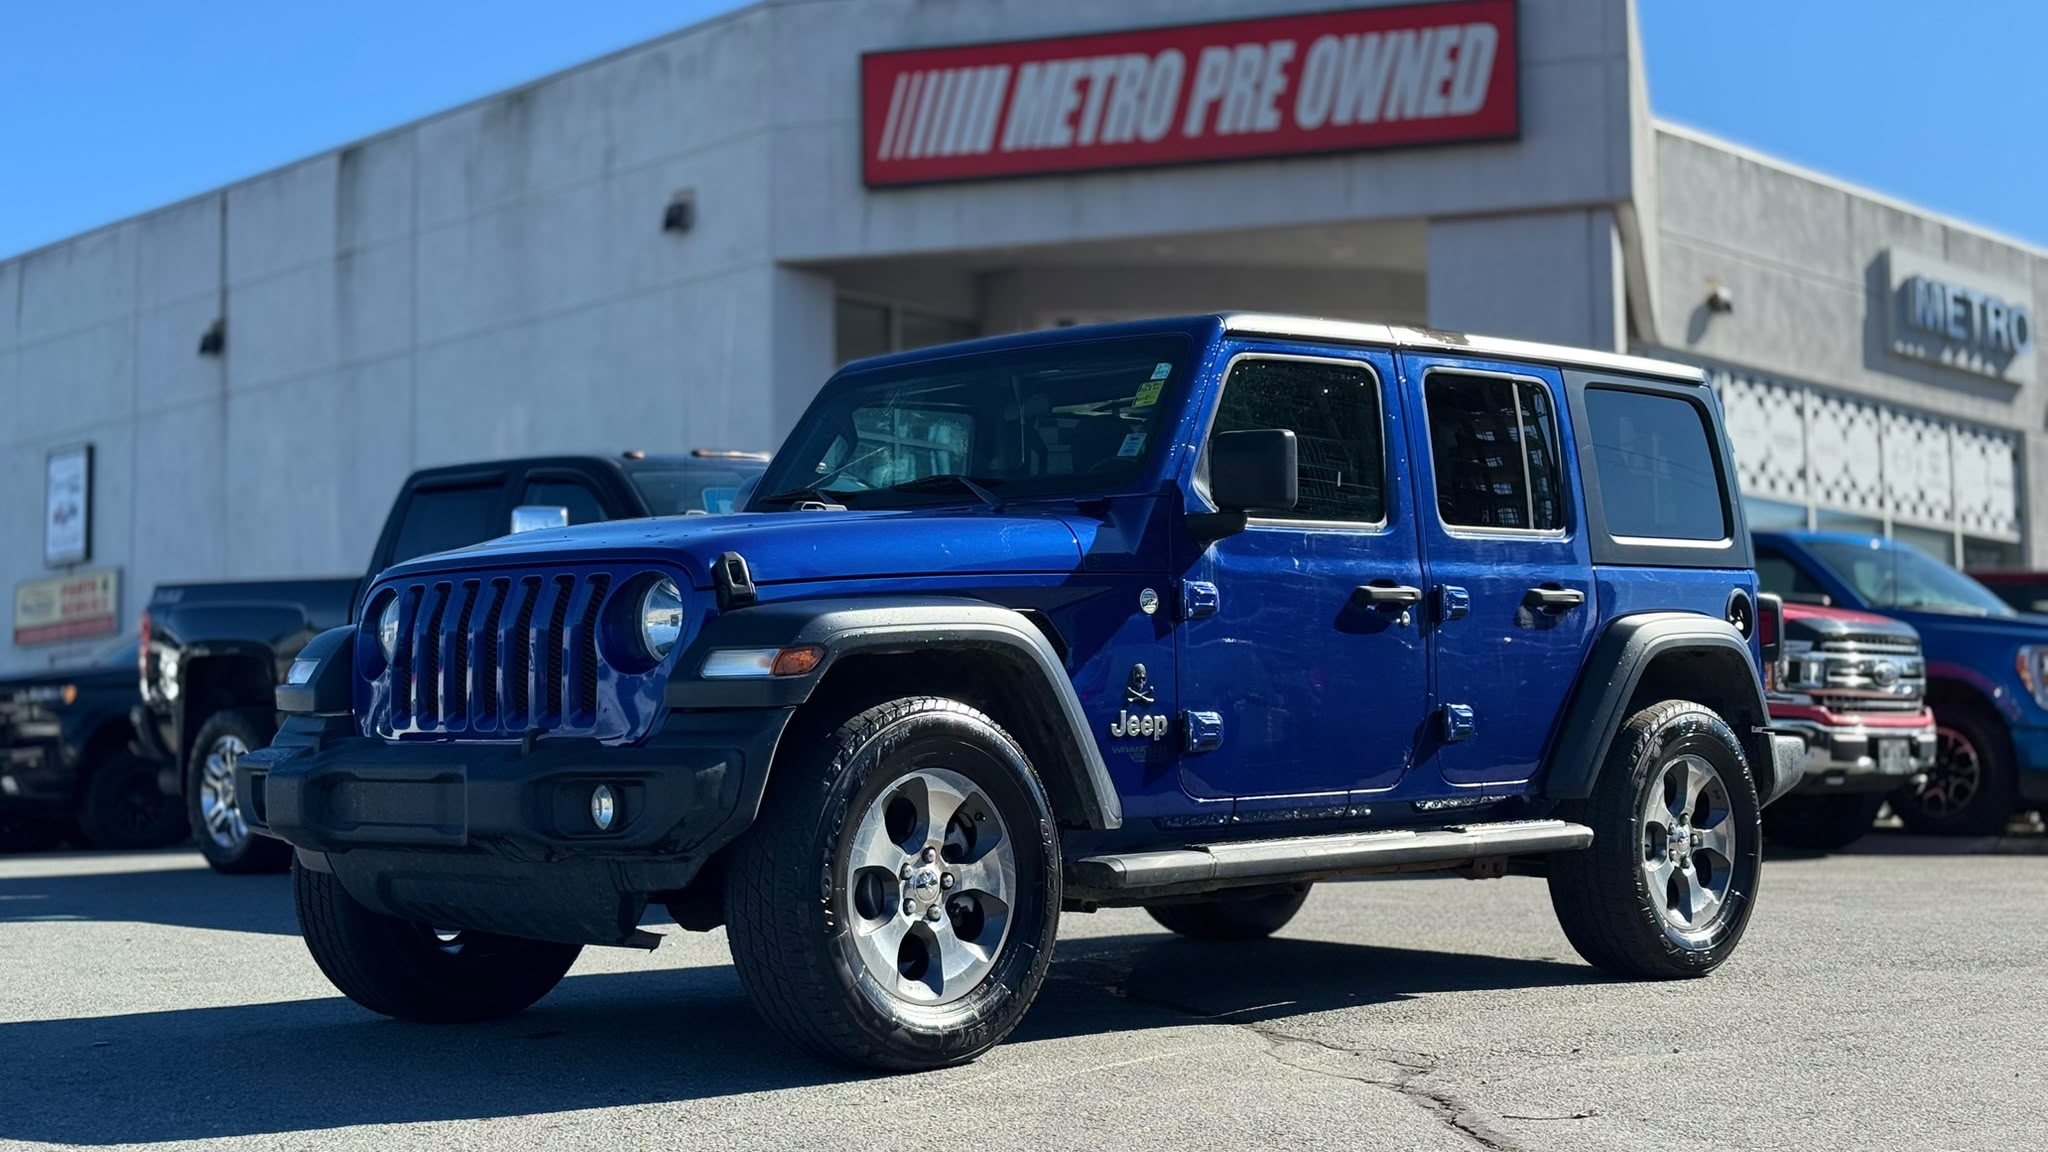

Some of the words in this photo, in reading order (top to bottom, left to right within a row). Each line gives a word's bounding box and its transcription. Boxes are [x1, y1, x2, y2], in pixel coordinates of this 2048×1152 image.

[1001, 48, 1186, 152] METRO
[1181, 40, 1297, 137] PRE
[1294, 22, 1498, 130] OWNED
[1914, 275, 2032, 356] METRO
[1111, 710, 1168, 741] Jeep
